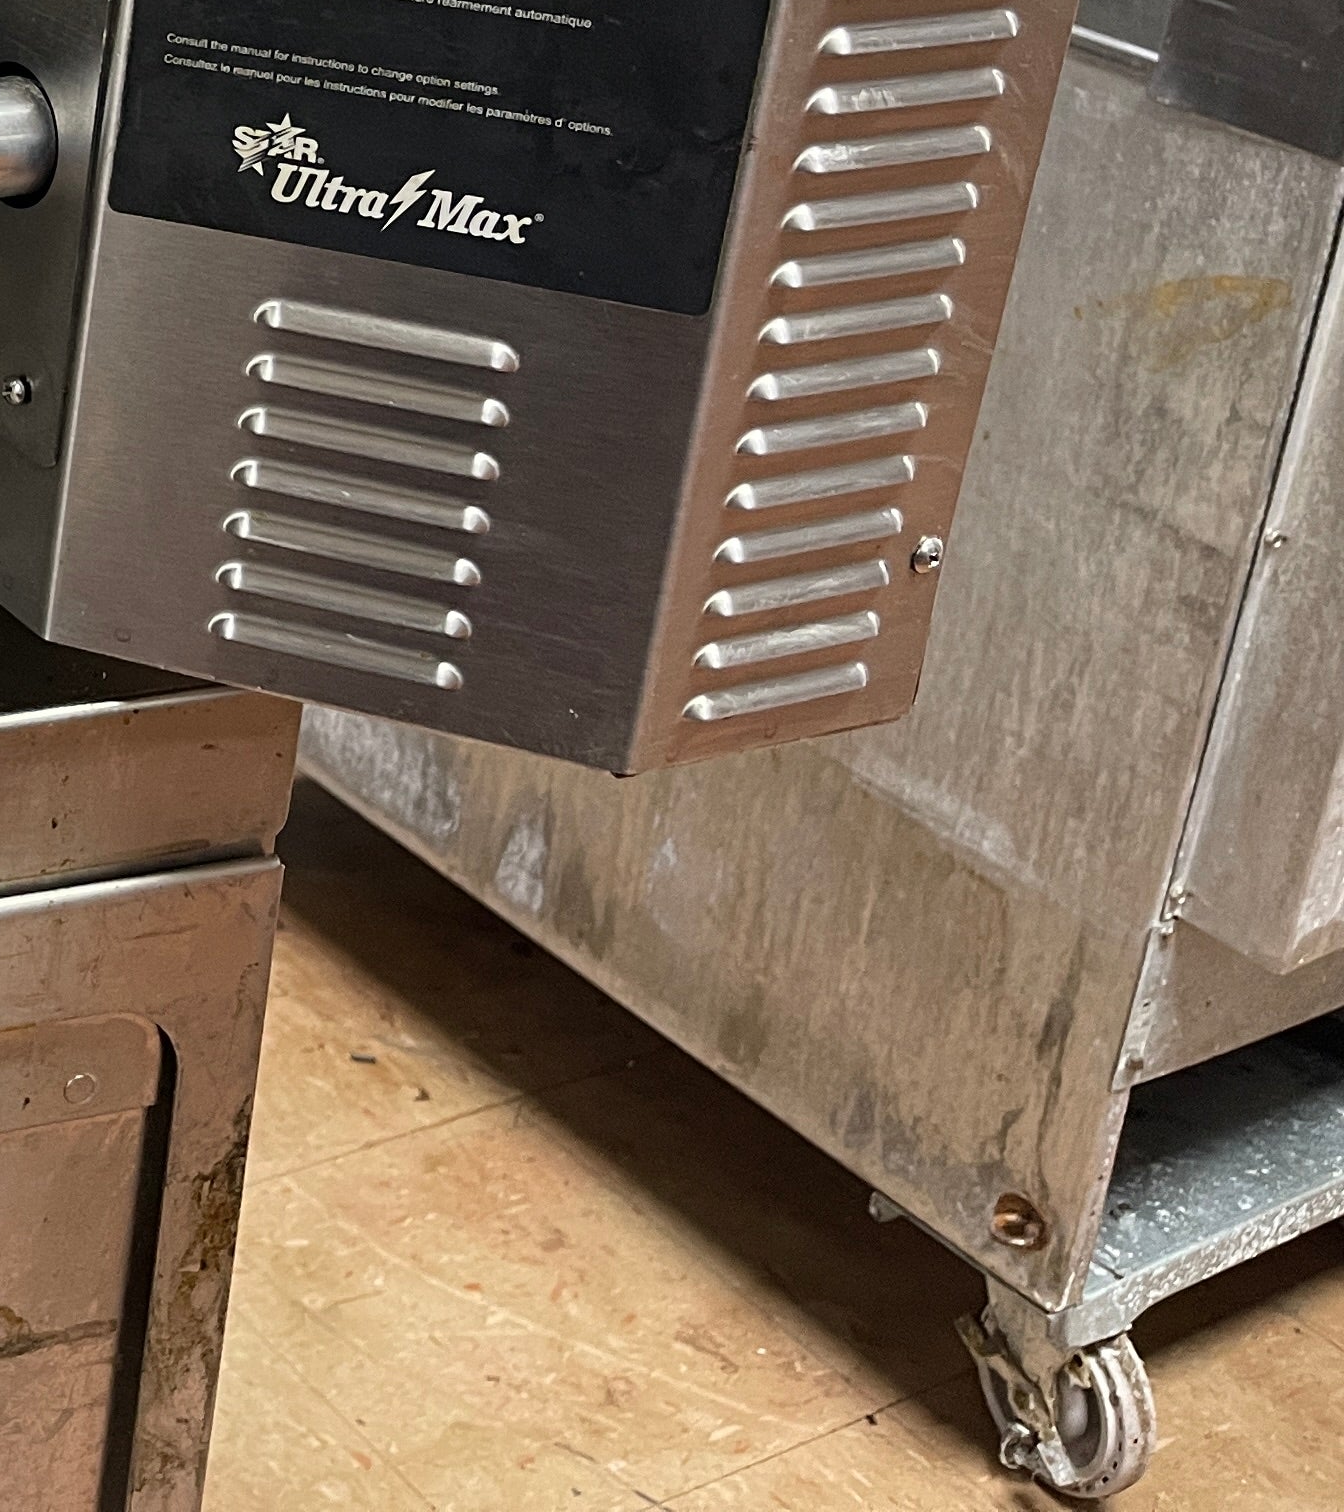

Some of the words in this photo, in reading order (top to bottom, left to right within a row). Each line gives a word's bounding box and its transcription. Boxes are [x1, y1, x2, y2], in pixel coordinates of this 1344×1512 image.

[163, 53, 218, 73] Consultez
[220, 62, 231, 74] le
[232, 65, 275, 81] manuel
[276, 72, 303, 85] pour
[303, 76, 321, 89] les
[323, 79, 388, 100] instructions
[388, 90, 416, 104] pour
[417, 94, 465, 112] modifier
[466, 101, 484, 115] les
[166, 32, 209, 49] Consult
[210, 39, 229, 52] the
[230, 44, 273, 59] manual
[273, 49, 290, 62] for
[291, 52, 356, 73] instructions
[357, 63, 369, 75] to
[370, 66, 413, 83] change
[415, 73, 452, 89] option
[270, 162, 390, 220] Ultra
